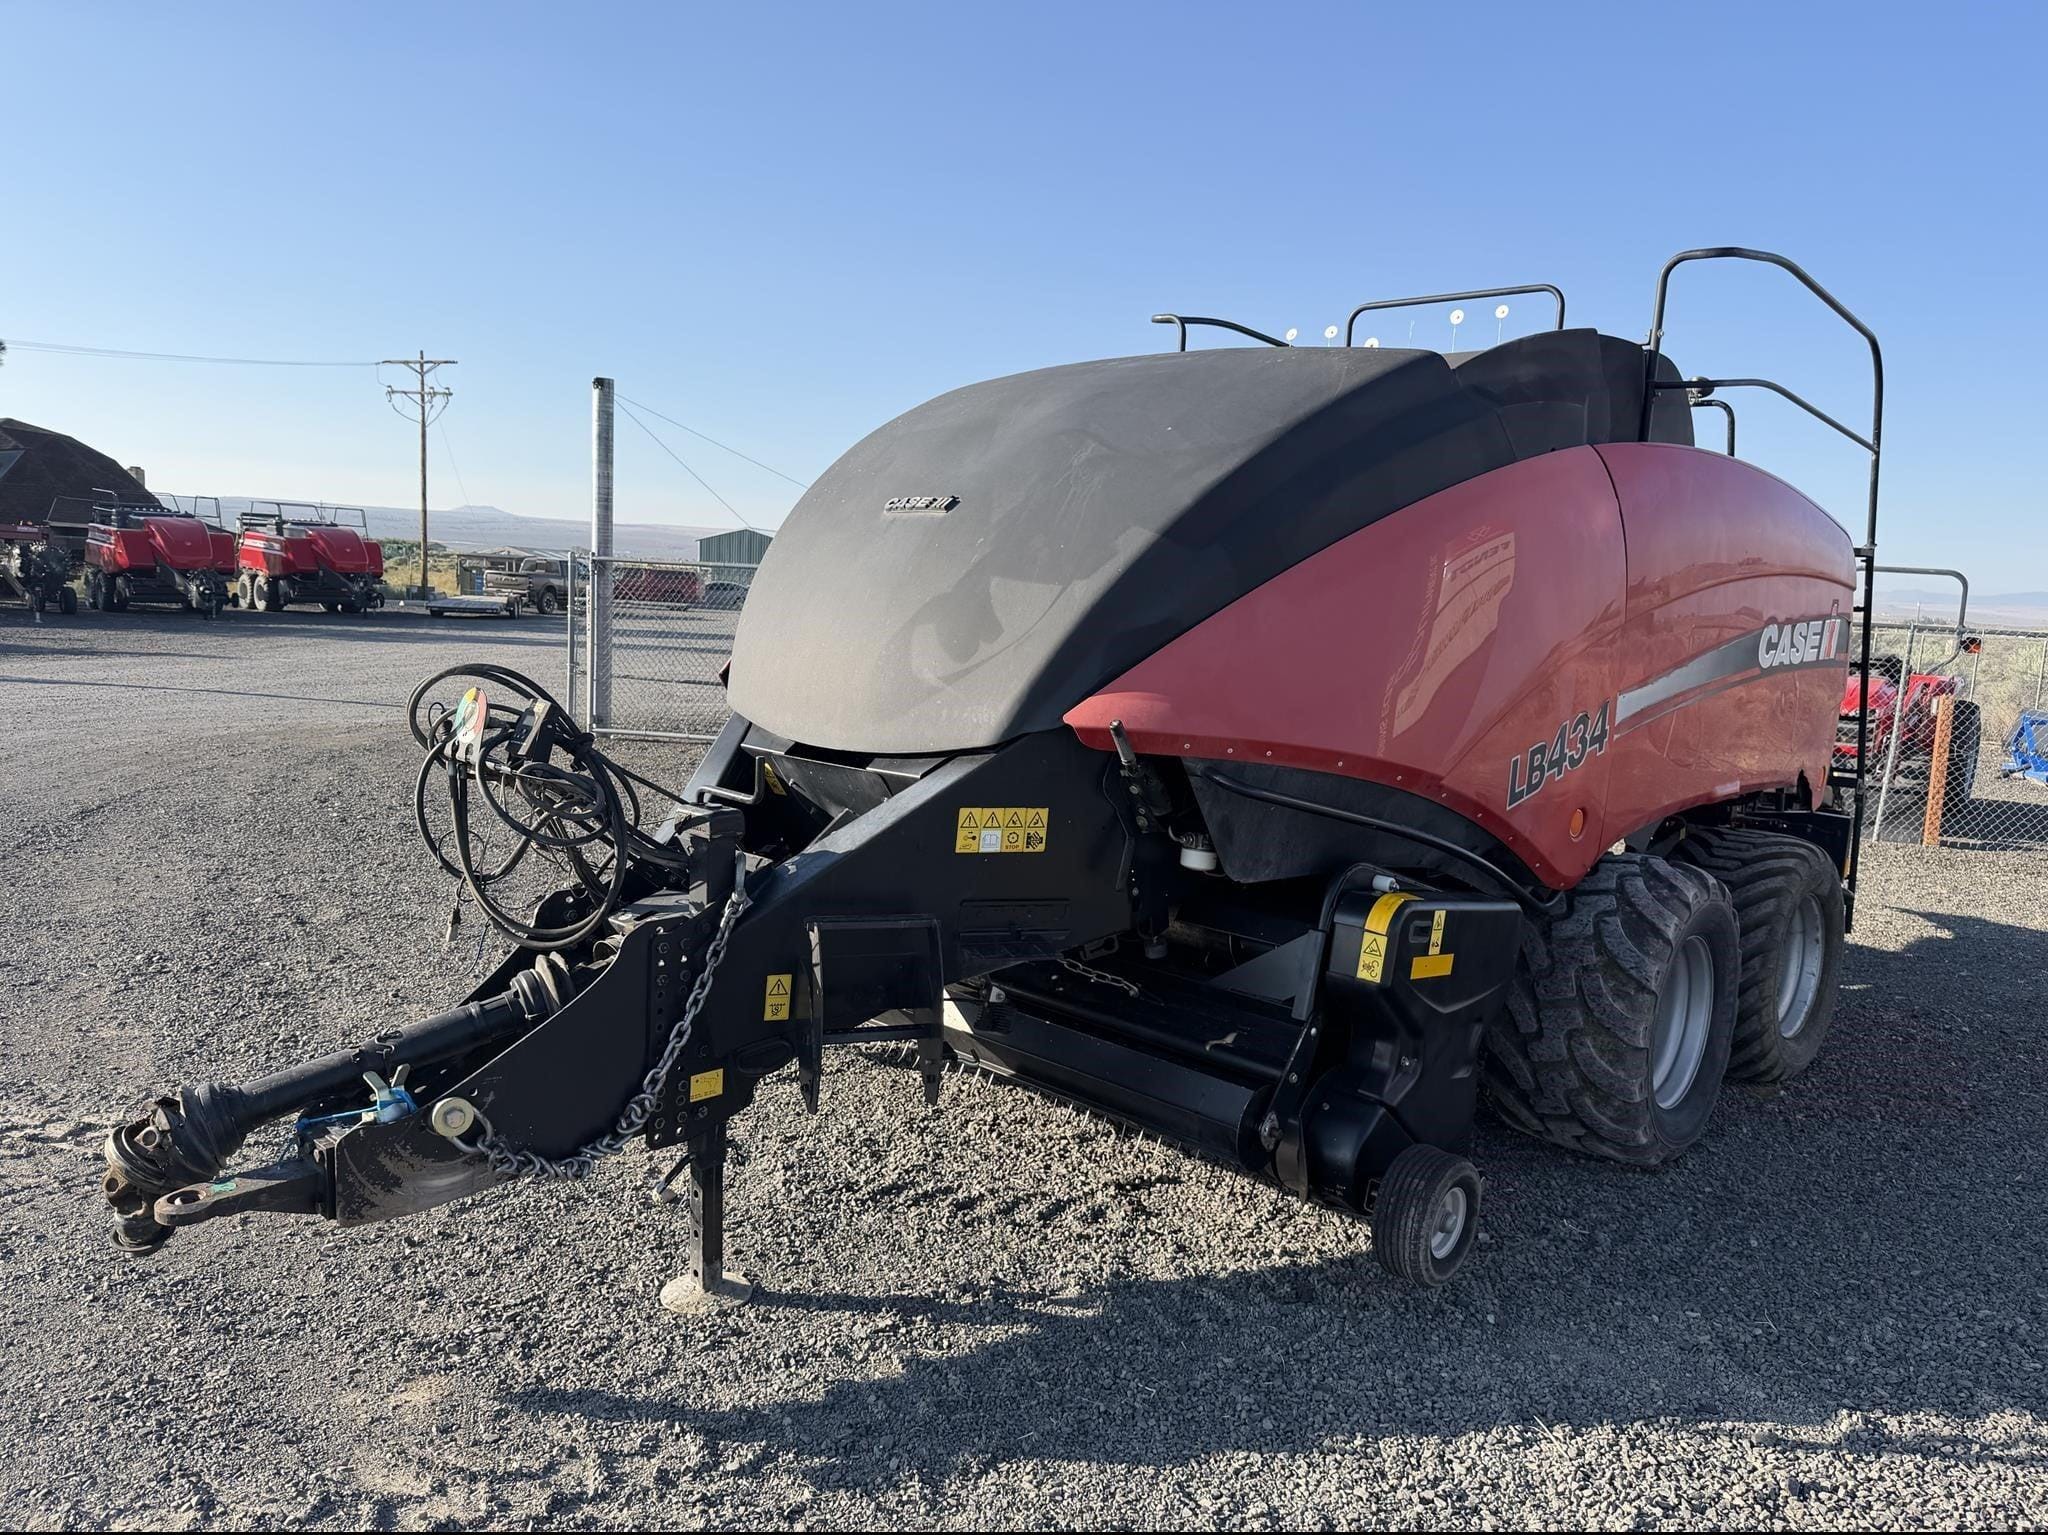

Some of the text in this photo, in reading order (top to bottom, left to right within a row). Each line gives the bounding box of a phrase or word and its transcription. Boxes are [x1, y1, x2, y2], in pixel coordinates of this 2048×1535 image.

[884, 497, 932, 511] CASE
[1758, 620, 1823, 669] CASE
[1506, 698, 1610, 811] LB434
